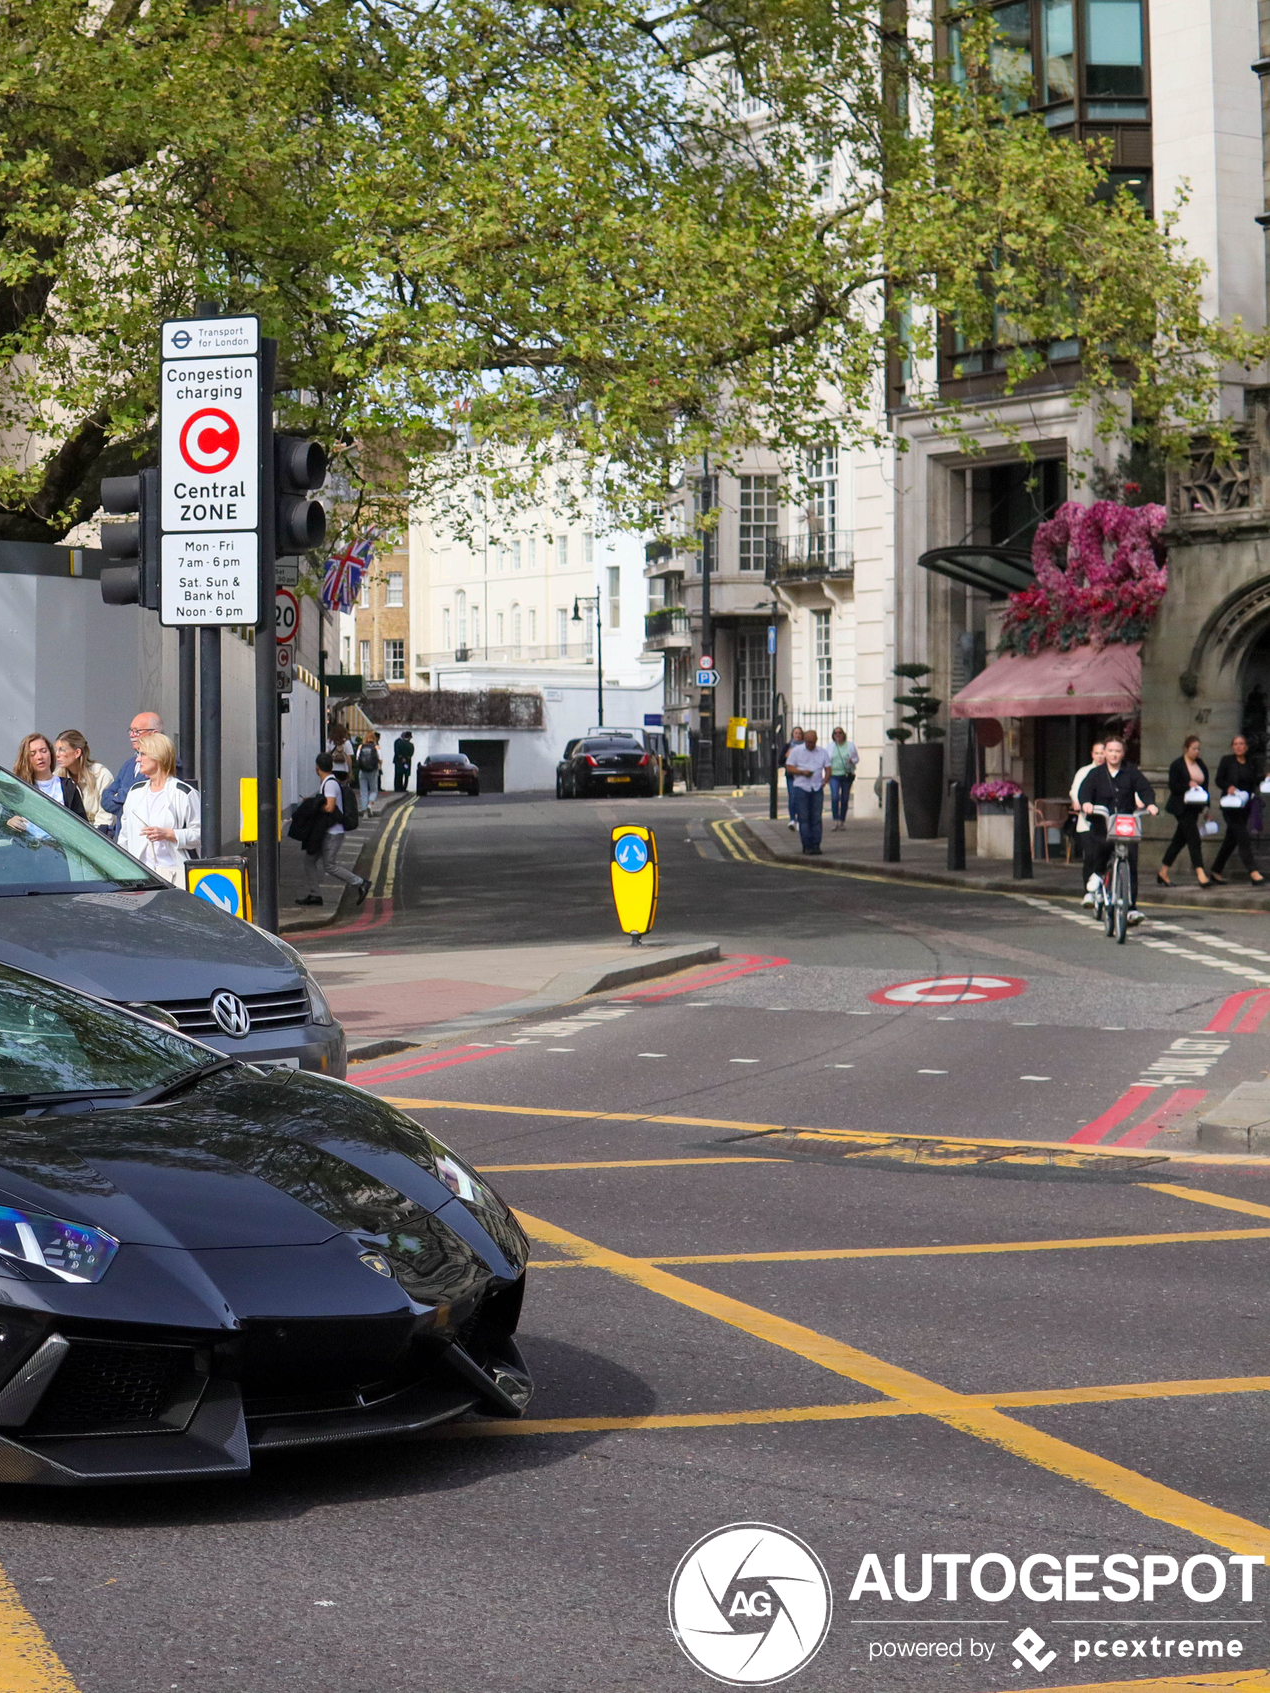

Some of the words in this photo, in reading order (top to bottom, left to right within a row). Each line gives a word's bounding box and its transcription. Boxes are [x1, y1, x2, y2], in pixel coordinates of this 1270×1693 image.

[198, 327, 244, 337] Transport
[198, 339, 212, 348] for
[215, 338, 249, 347] London
[166, 366, 253, 384] Congestion
[176, 384, 243, 401] charging
[173, 480, 246, 500] Central
[180, 503, 238, 522] ZONE
[185, 541, 210, 552] Mon
[219, 540, 235, 551] Fri
[178, 557, 185, 568] 7
[187, 559, 204, 568] am
[213, 556, 221, 567] 6
[223, 558, 241, 569] pm
[206, 577, 229, 588] Sun
[232, 576, 241, 587] &
[184, 590, 213, 601] Bank
[217, 589, 235, 600] hol
[176, 606, 207, 617] Noon
[216, 605, 223, 617] 6
[225, 607, 243, 618] pm
[275, 606, 294, 628] 20
